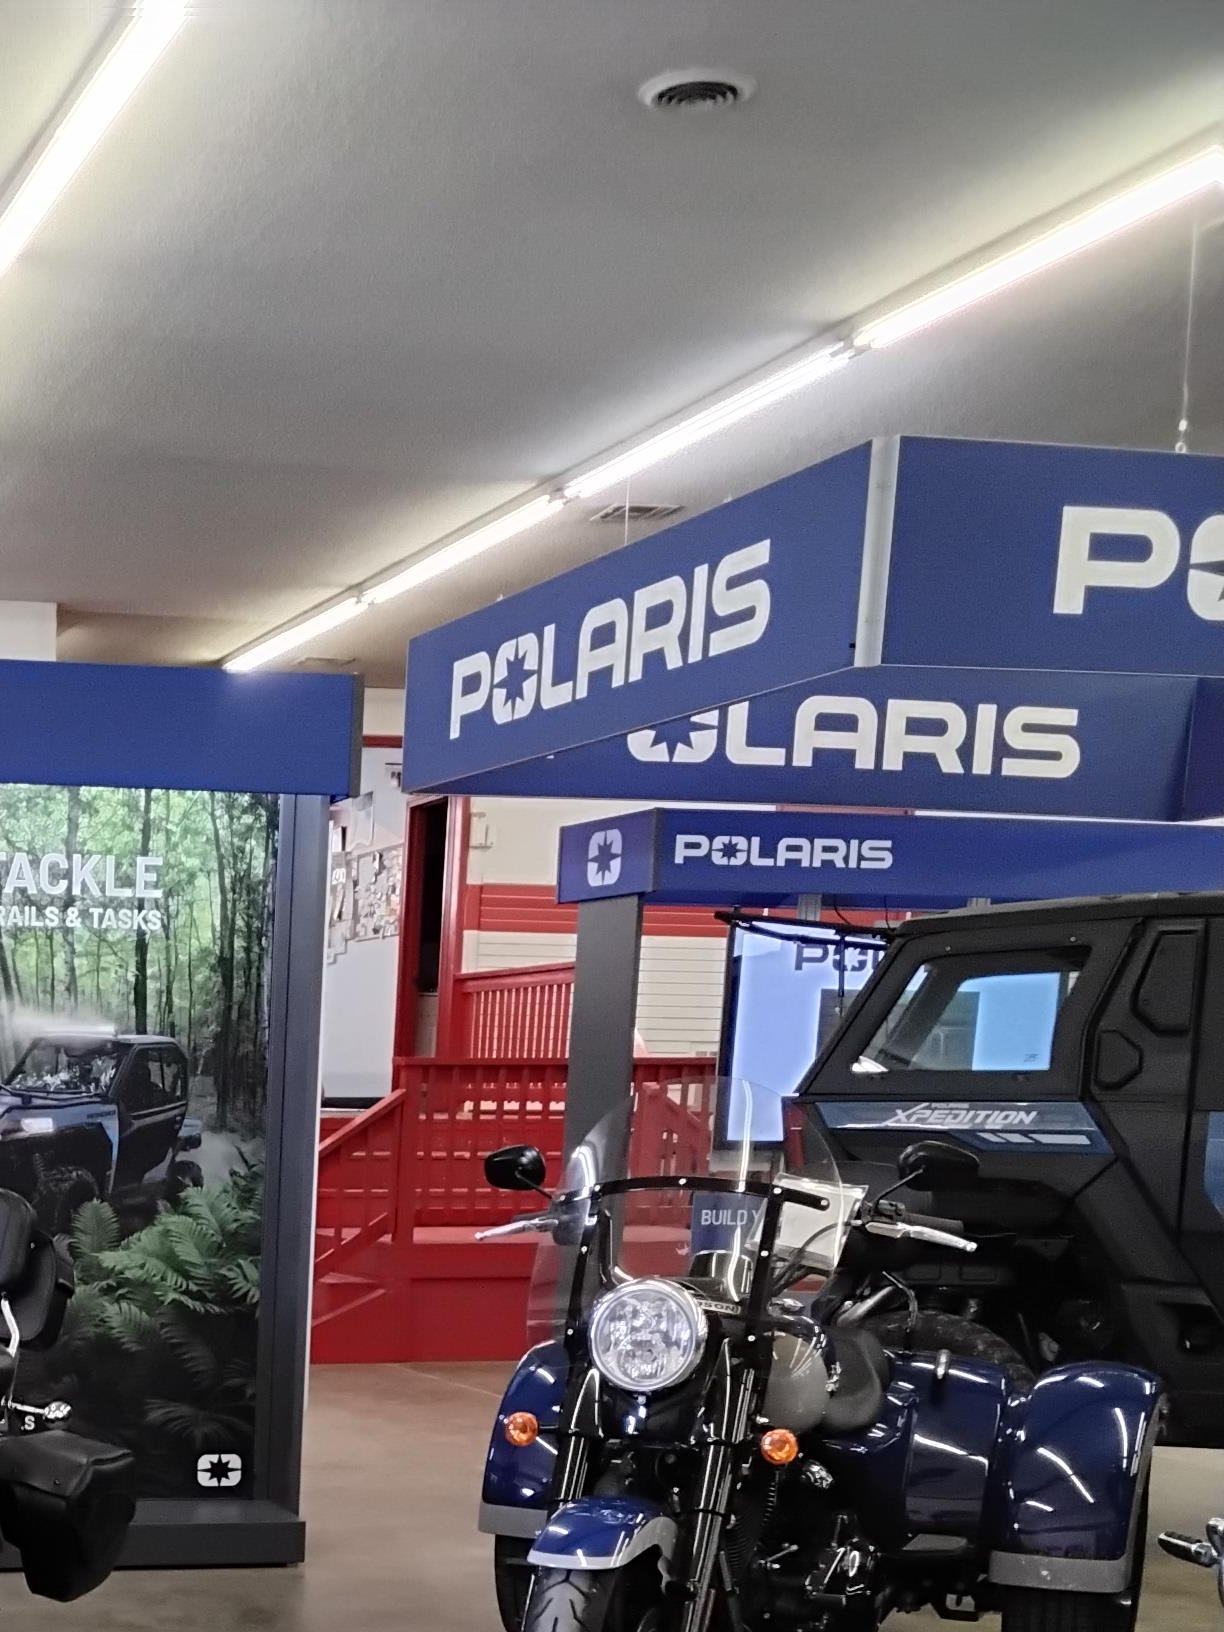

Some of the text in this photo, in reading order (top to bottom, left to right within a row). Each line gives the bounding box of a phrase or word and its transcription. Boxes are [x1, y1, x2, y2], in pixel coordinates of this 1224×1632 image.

[1052, 505, 1224, 622] P
[449, 538, 772, 741] POLARIS
[627, 694, 1081, 779] OLARIS
[674, 833, 894, 870] POLARIS
[65, 906, 82, 928] &
[88, 907, 162, 931] TASKS
[794, 942, 881, 972] PO
[881, 1102, 1038, 1126] XPEDITION
[700, 1209, 748, 1226] BUILD
